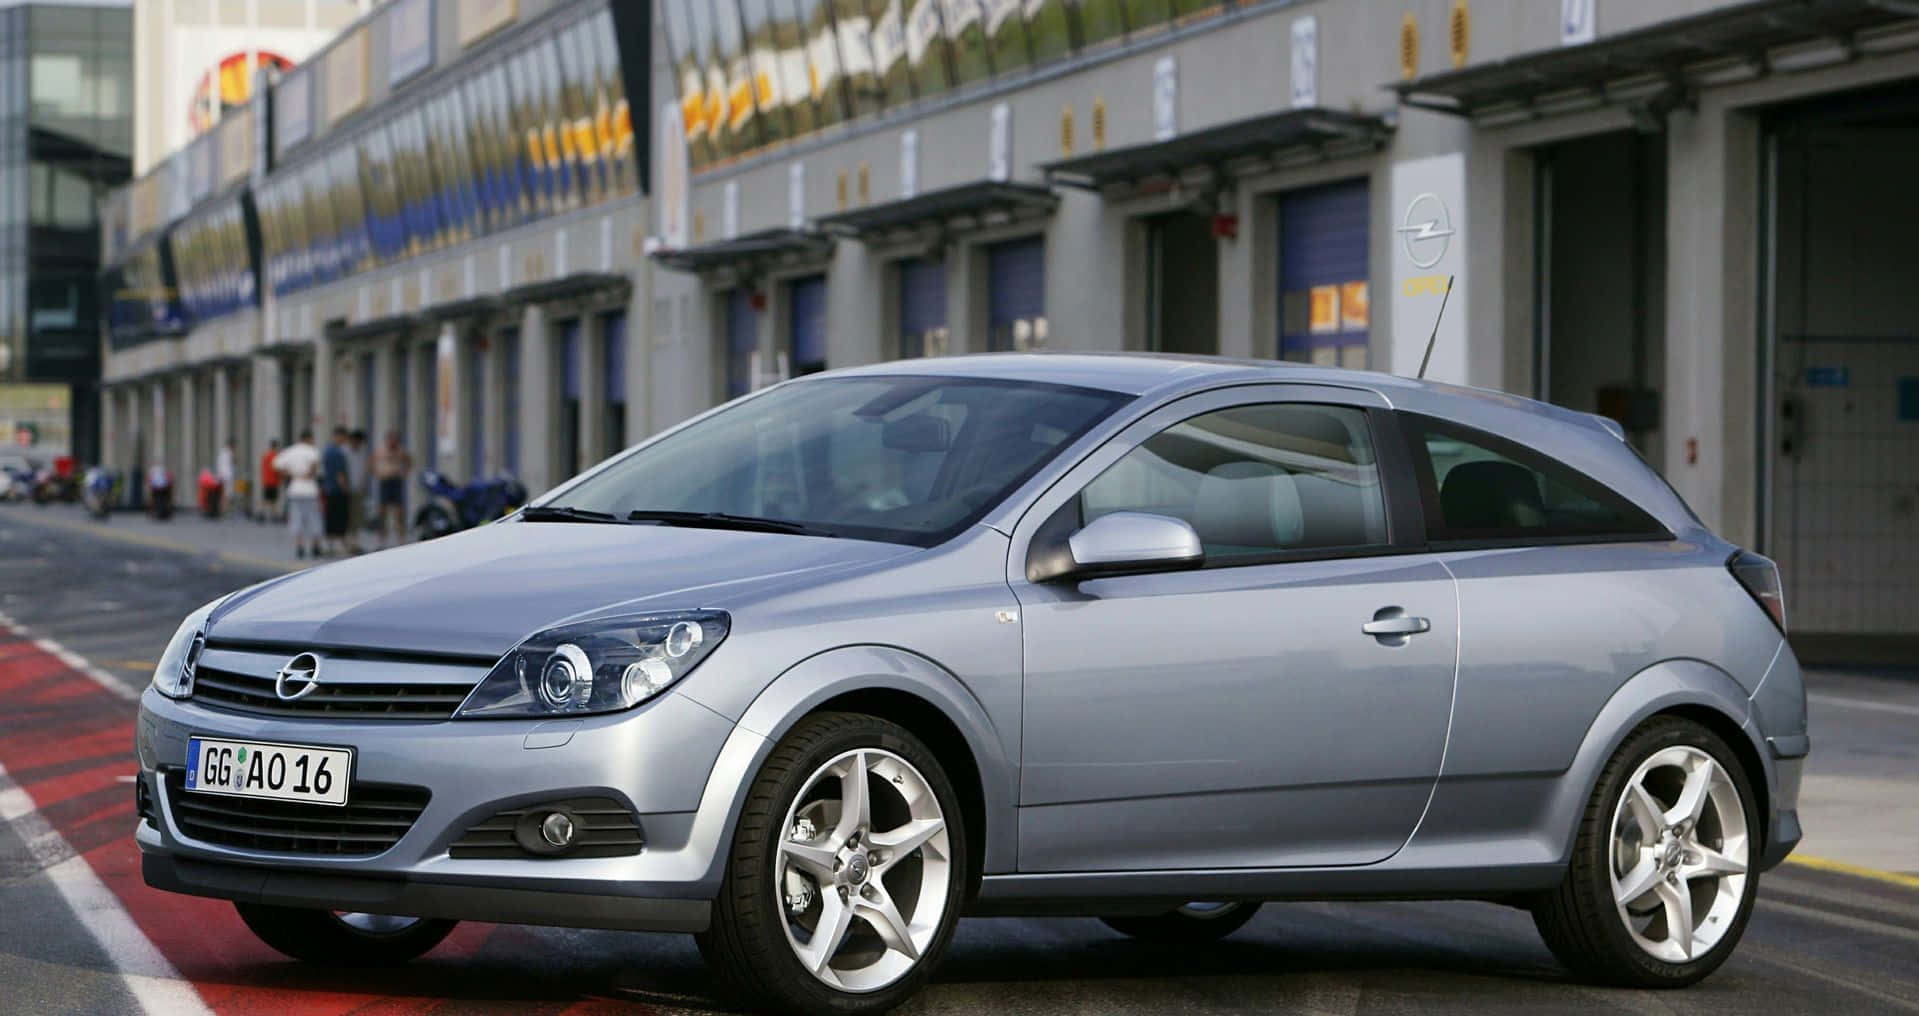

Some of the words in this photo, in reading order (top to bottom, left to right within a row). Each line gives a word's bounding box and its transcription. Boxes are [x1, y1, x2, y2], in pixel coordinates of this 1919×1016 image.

[204, 747, 232, 786] GG
[246, 750, 286, 790] AO
[293, 754, 332, 795] 16
